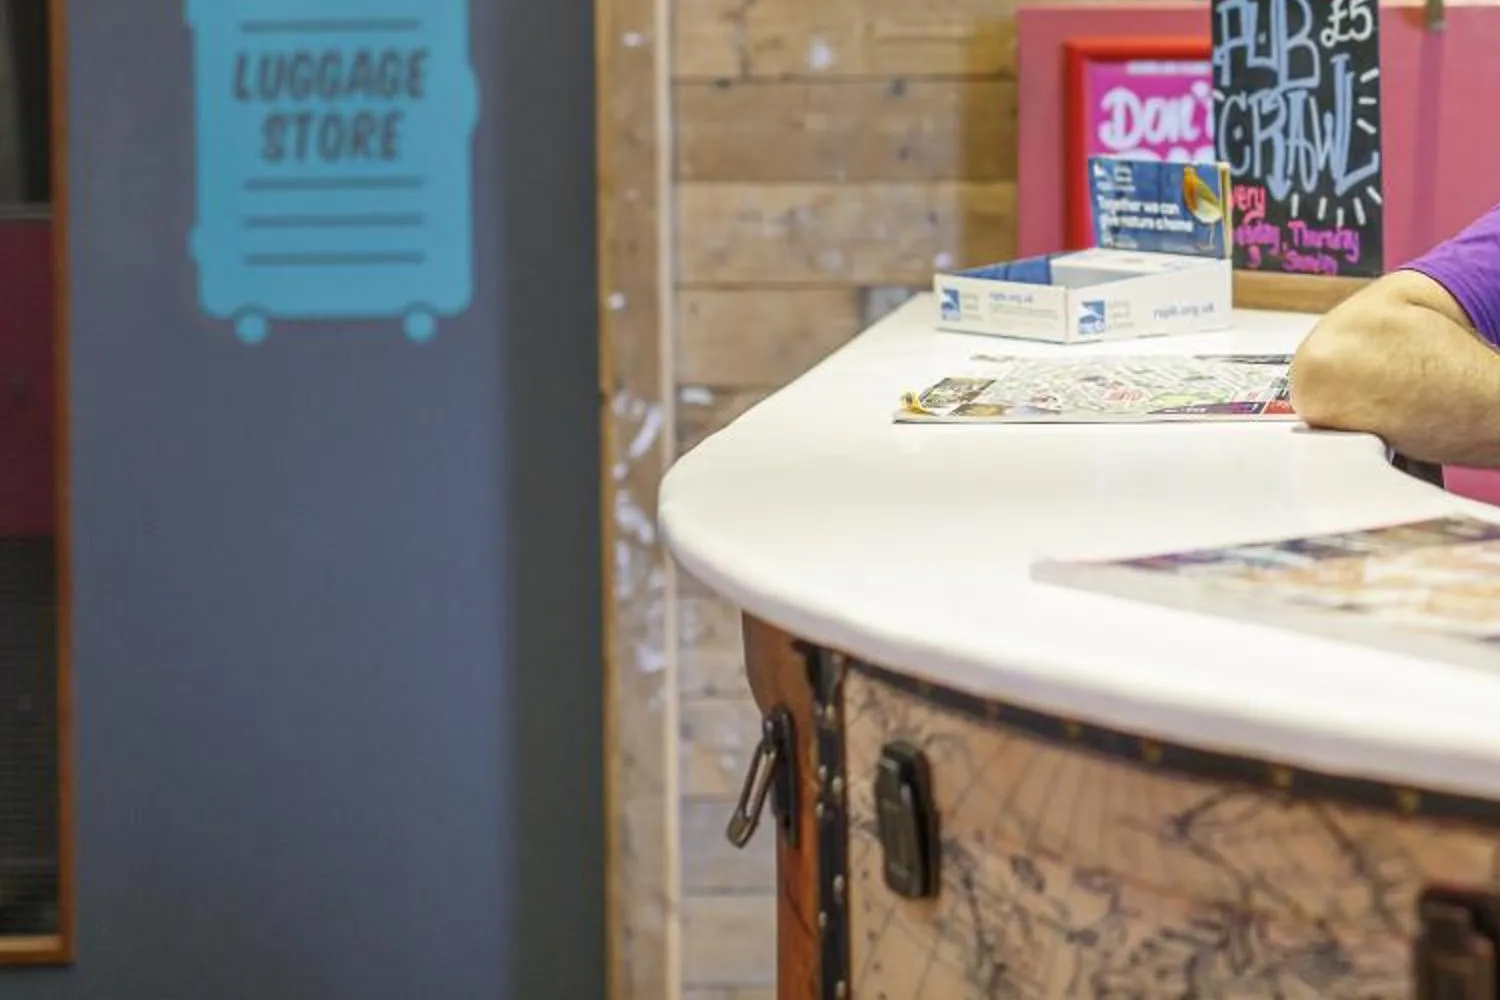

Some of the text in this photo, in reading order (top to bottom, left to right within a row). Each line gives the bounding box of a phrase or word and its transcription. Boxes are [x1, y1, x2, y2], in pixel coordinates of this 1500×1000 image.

[233, 46, 429, 101] LUGGAGE
[261, 110, 405, 163] STORE
[1217, 53, 1380, 201] CRAWL
[1230, 184, 1266, 224] very
